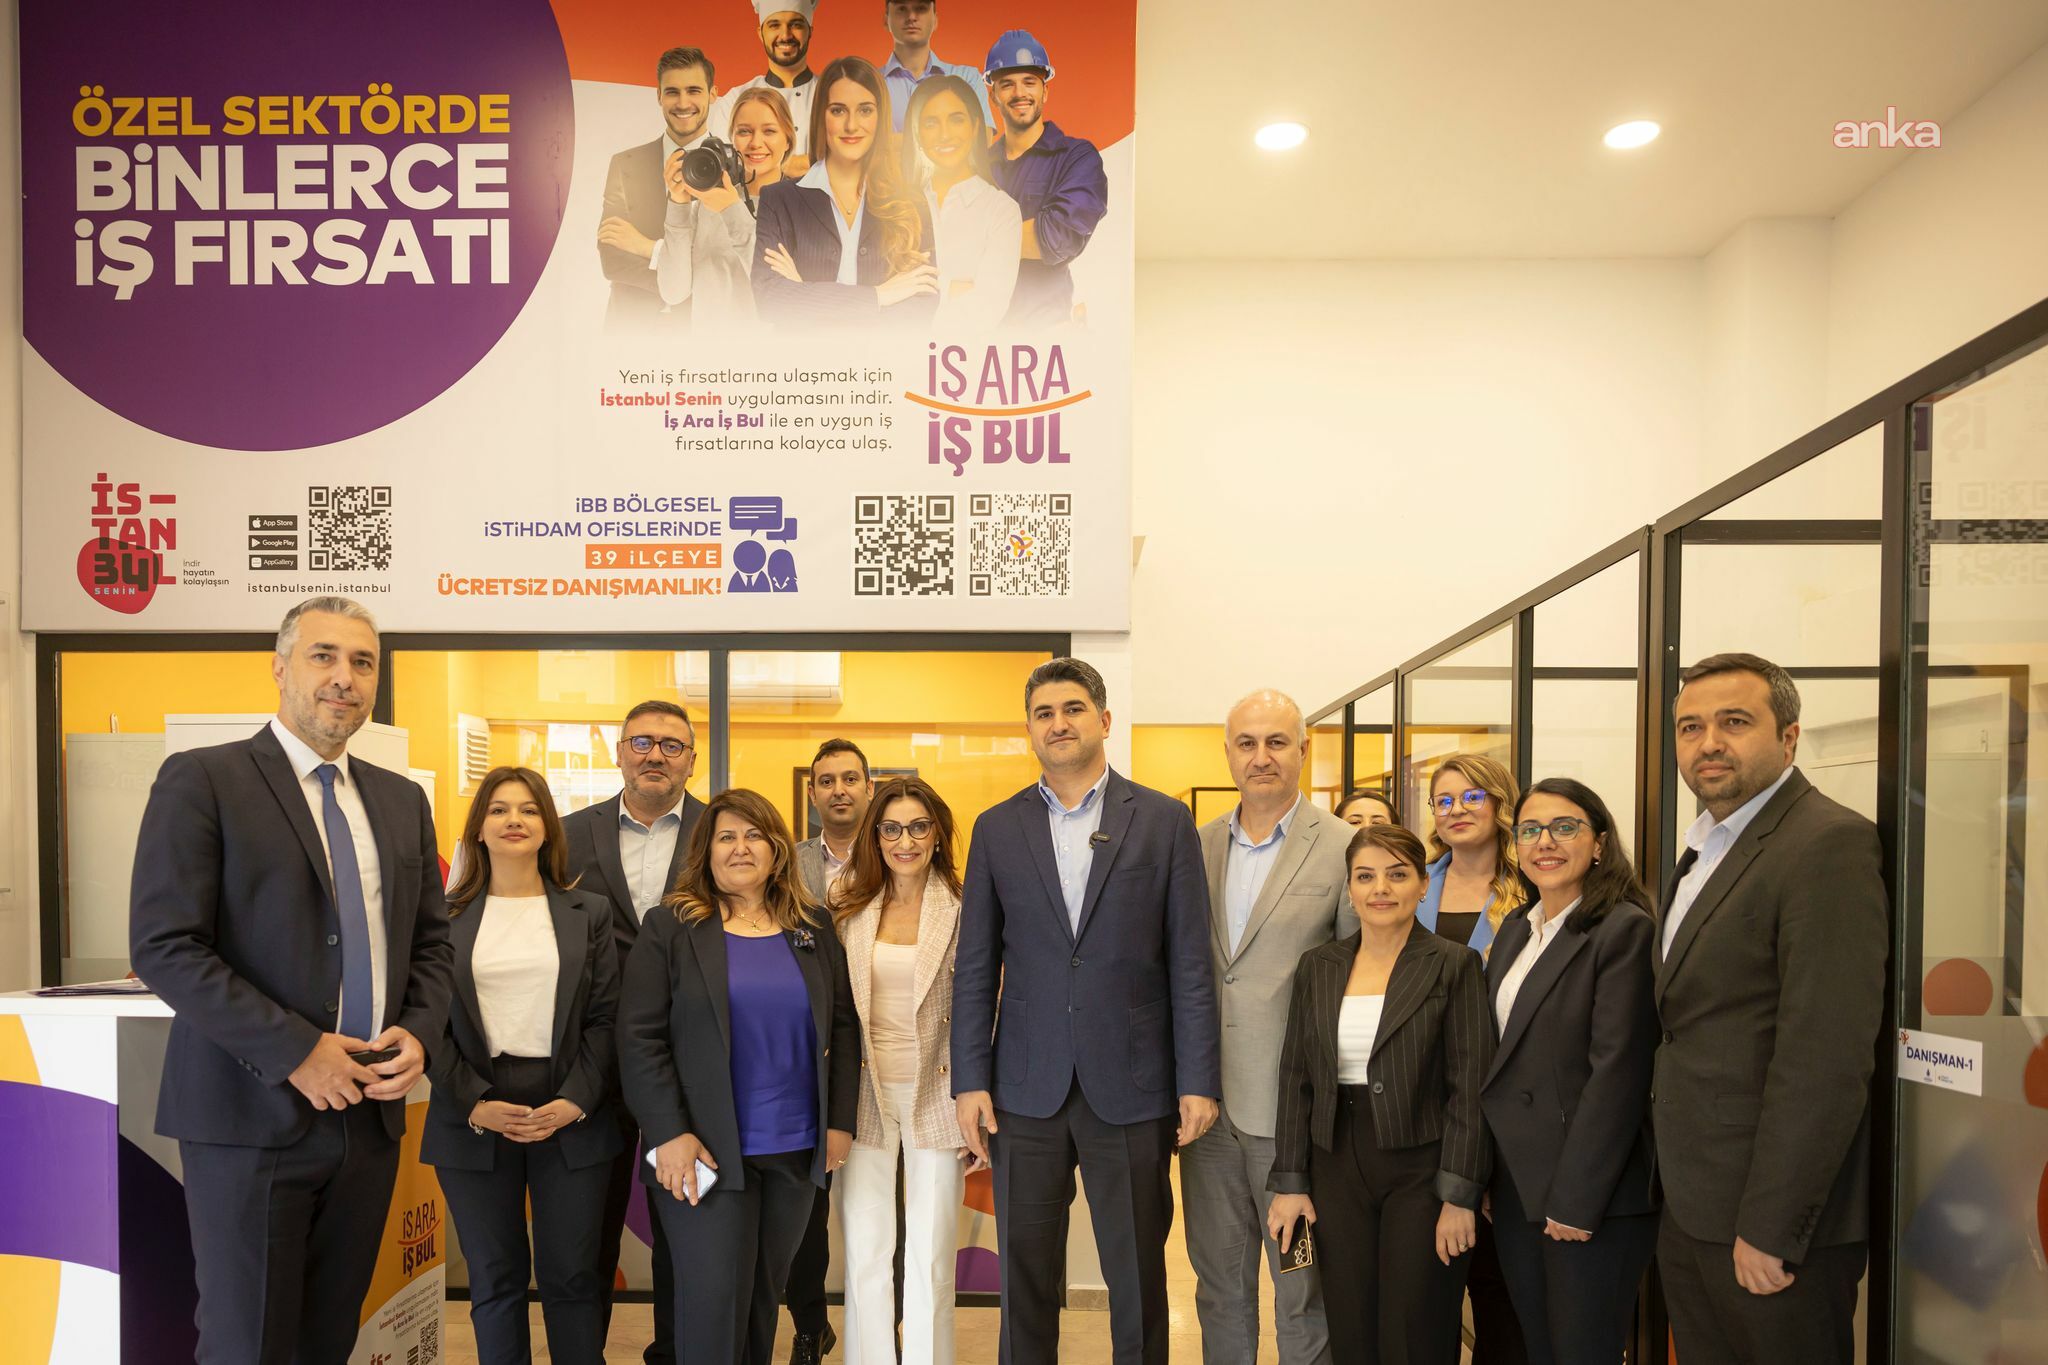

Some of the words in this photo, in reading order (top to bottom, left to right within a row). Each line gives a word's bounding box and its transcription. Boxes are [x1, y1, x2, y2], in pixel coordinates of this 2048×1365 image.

[72, 85, 210, 137] ÖZEL
[223, 82, 510, 135] SEKTÖRDE
[174, 218, 510, 286] FIRSATI
[619, 369, 655, 384] Yeni
[660, 369, 674, 386] iş
[678, 368, 777, 384] fırsatlarına
[783, 368, 858, 386] ulaşmak
[863, 368, 892, 385] için
[975, 345, 1071, 405] ARA
[600, 388, 671, 407] İstanbul
[674, 391, 722, 406] Senin
[728, 390, 844, 409] uygulamasını
[850, 390, 892, 405] indir.
[664, 410, 679, 431] İş
[683, 413, 714, 428] Ara
[718, 410, 733, 431] İş
[737, 413, 764, 428] Bul
[769, 413, 788, 428] ile
[794, 416, 815, 428] en
[820, 415, 873, 431] uygun
[879, 413, 892, 429] iş
[675, 436, 774, 451] fırsatlarına
[780, 435, 846, 453] kolayca
[852, 435, 892, 451] ulaş.
[983, 412, 1071, 464] BUL
[613, 493, 722, 513] BÖLGESEL
[591, 550, 618, 565] 39
[183, 569, 215, 577] hayatın
[183, 578, 229, 587] kolaylaşsın
[248, 583, 391, 593] istanbulsenin.istanbul
[552, 577, 722, 599] DANIŞMANLIK!
[1906, 1046, 1973, 1071] DANIŞMAN-1
[414, 1199, 436, 1238] ARA
[416, 1232, 436, 1268] BUL
